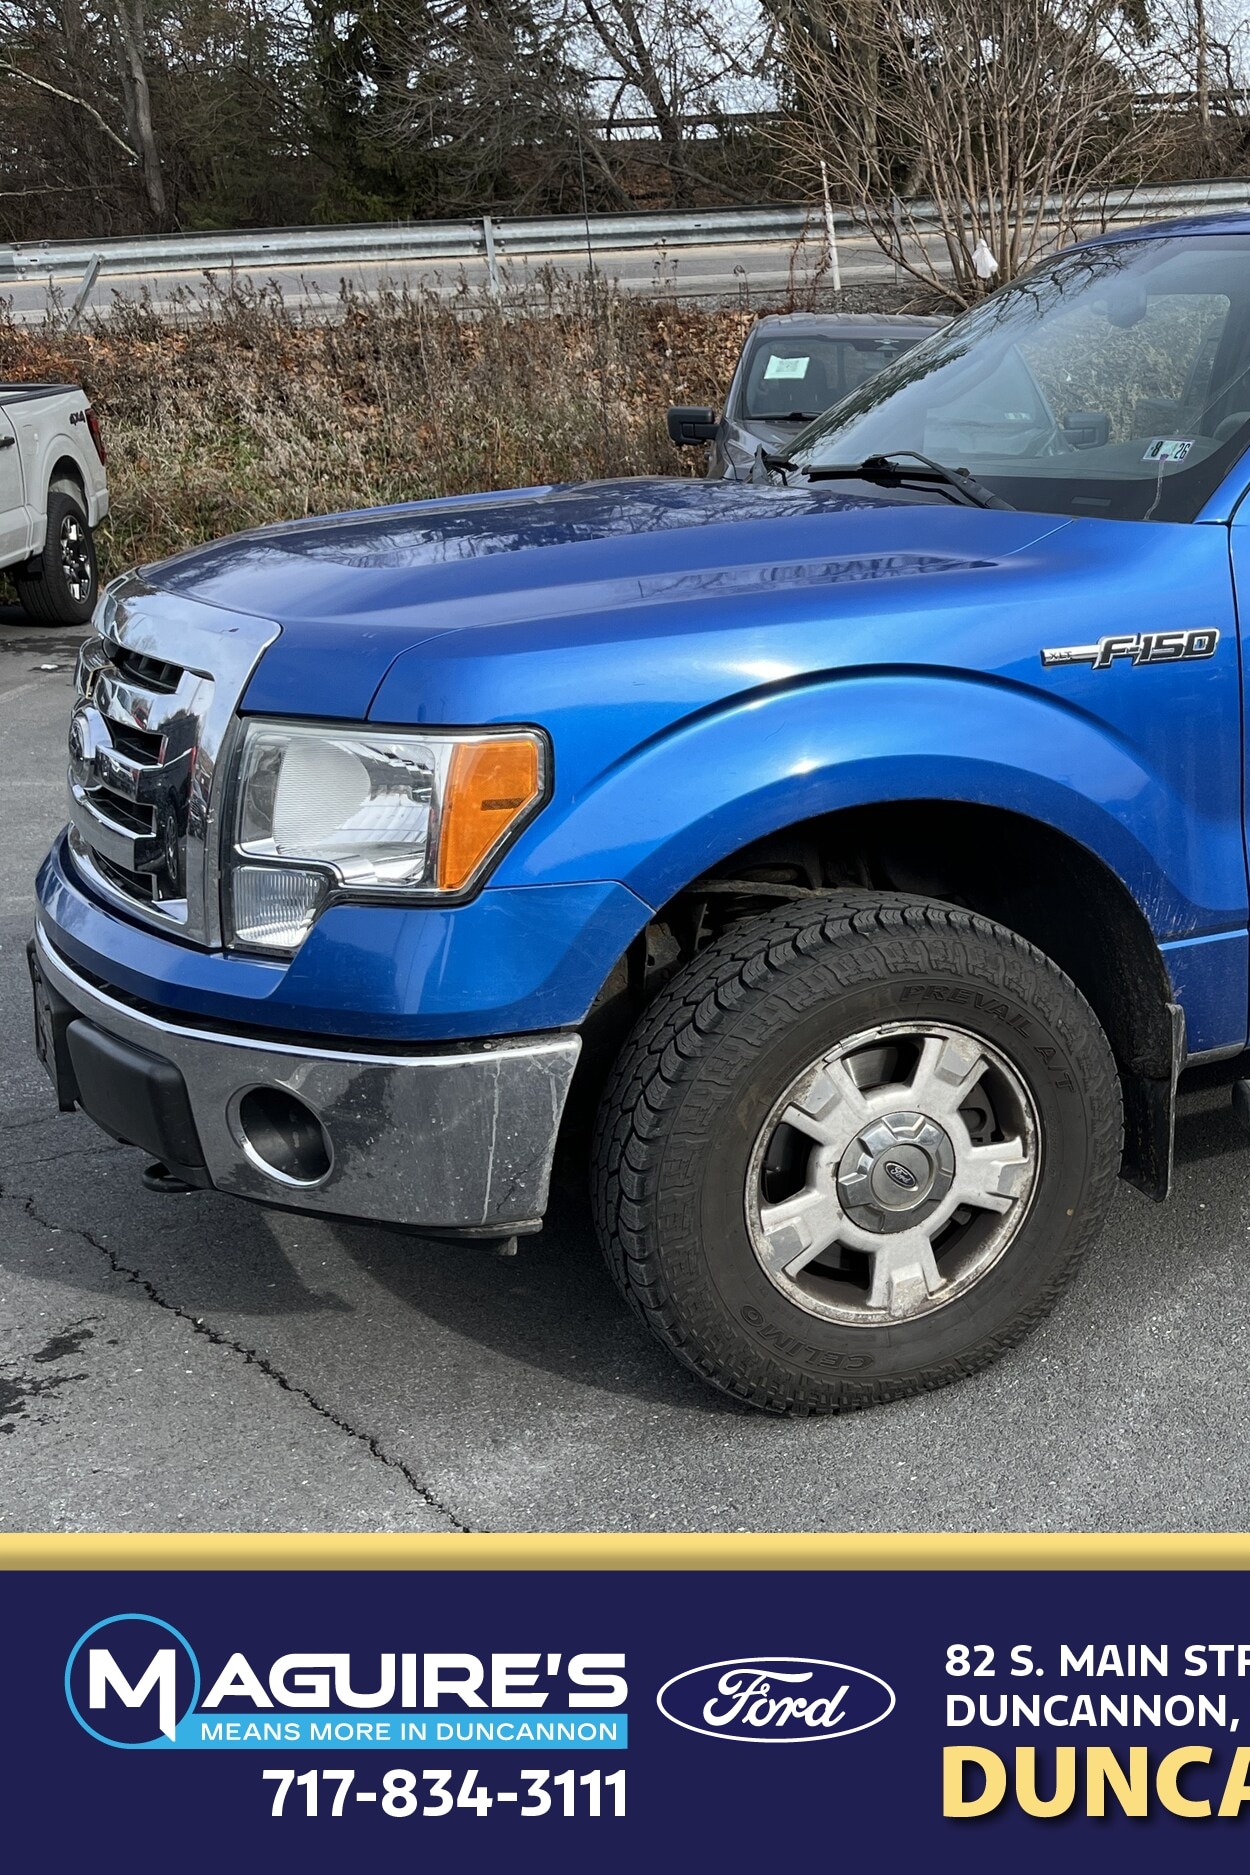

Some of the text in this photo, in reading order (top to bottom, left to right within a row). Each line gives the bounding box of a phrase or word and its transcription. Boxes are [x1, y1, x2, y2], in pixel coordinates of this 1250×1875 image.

[1049, 627, 1221, 670] XLT F-150
[900, 984, 1076, 1094] PREVAIL A/T
[740, 1303, 874, 1371] CELIMO
